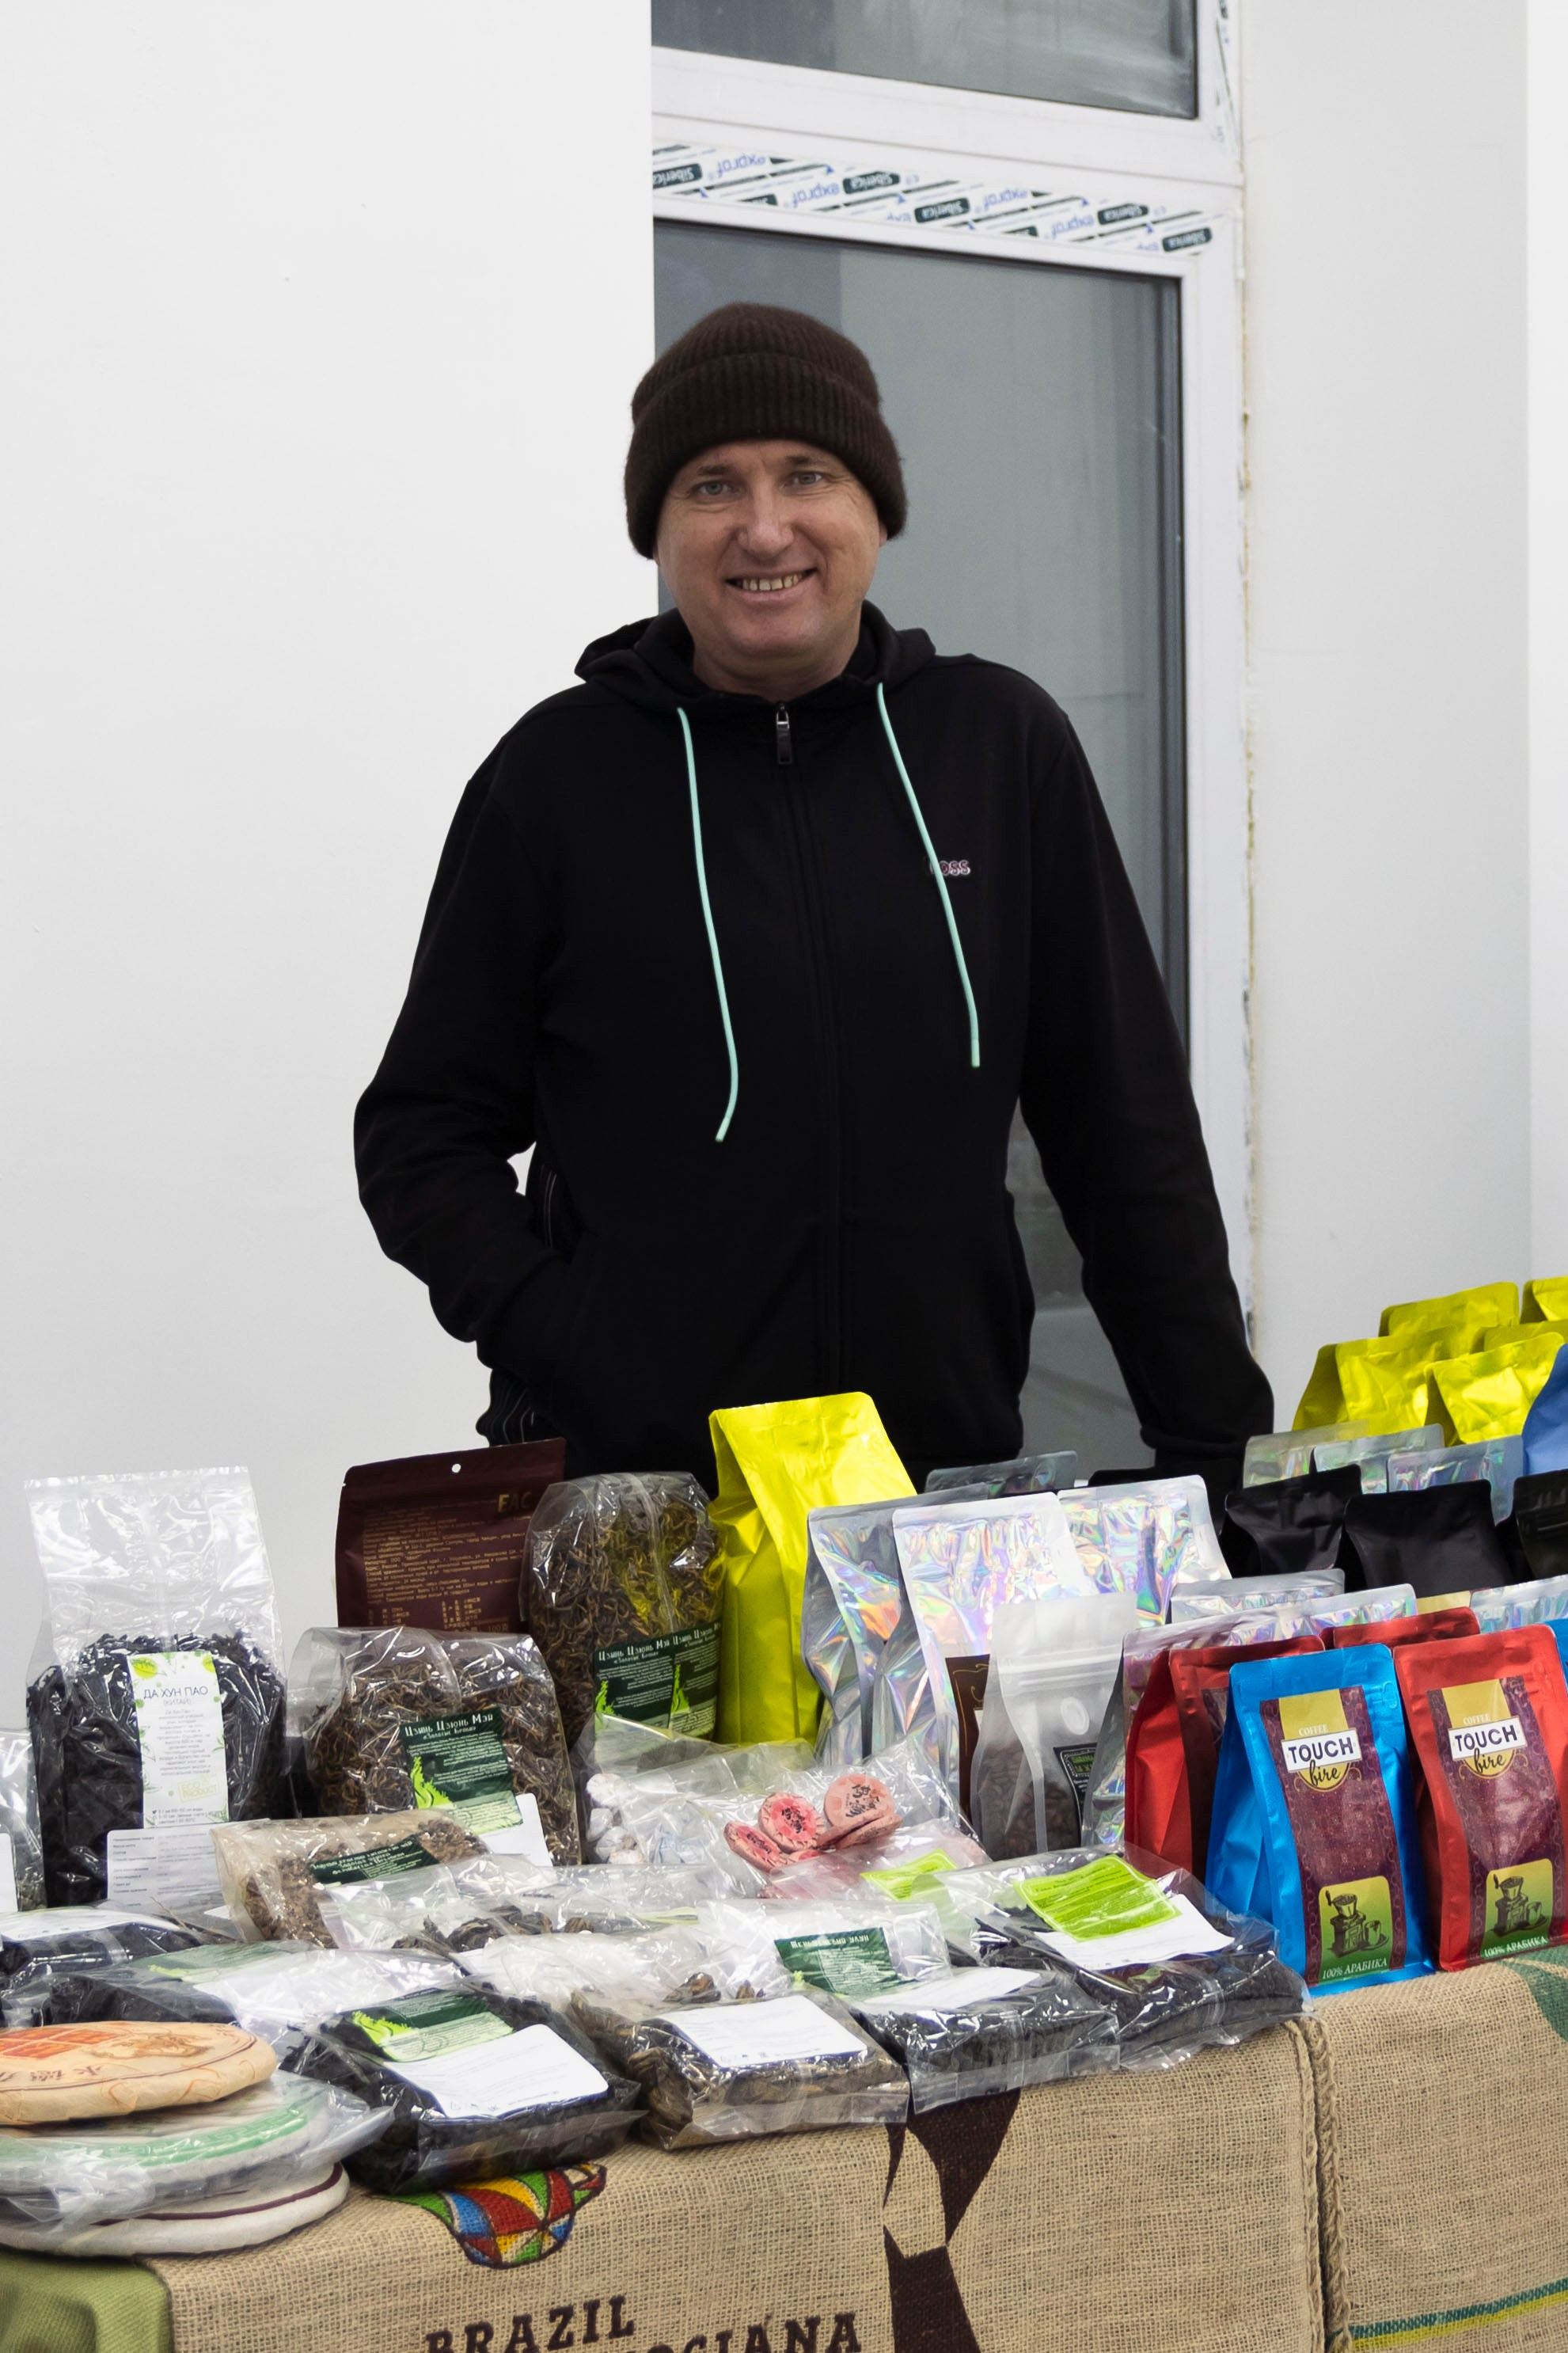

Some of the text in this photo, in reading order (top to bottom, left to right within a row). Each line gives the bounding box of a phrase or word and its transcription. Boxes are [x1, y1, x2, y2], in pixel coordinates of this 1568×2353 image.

[929, 860, 971, 876] OSS
[143, 1685, 209, 1700] ДА ХУН ПАО
[1298, 1724, 1329, 1736] COFFEE
[1455, 1724, 1518, 1752] TOUCH
[1288, 1737, 1353, 1764] TOUCH
[1506, 1936, 1548, 1952] АРАБИКА
[1323, 1957, 1388, 1979] 100% АРАБИКА
[425, 2295, 635, 2353] BRAZIL
